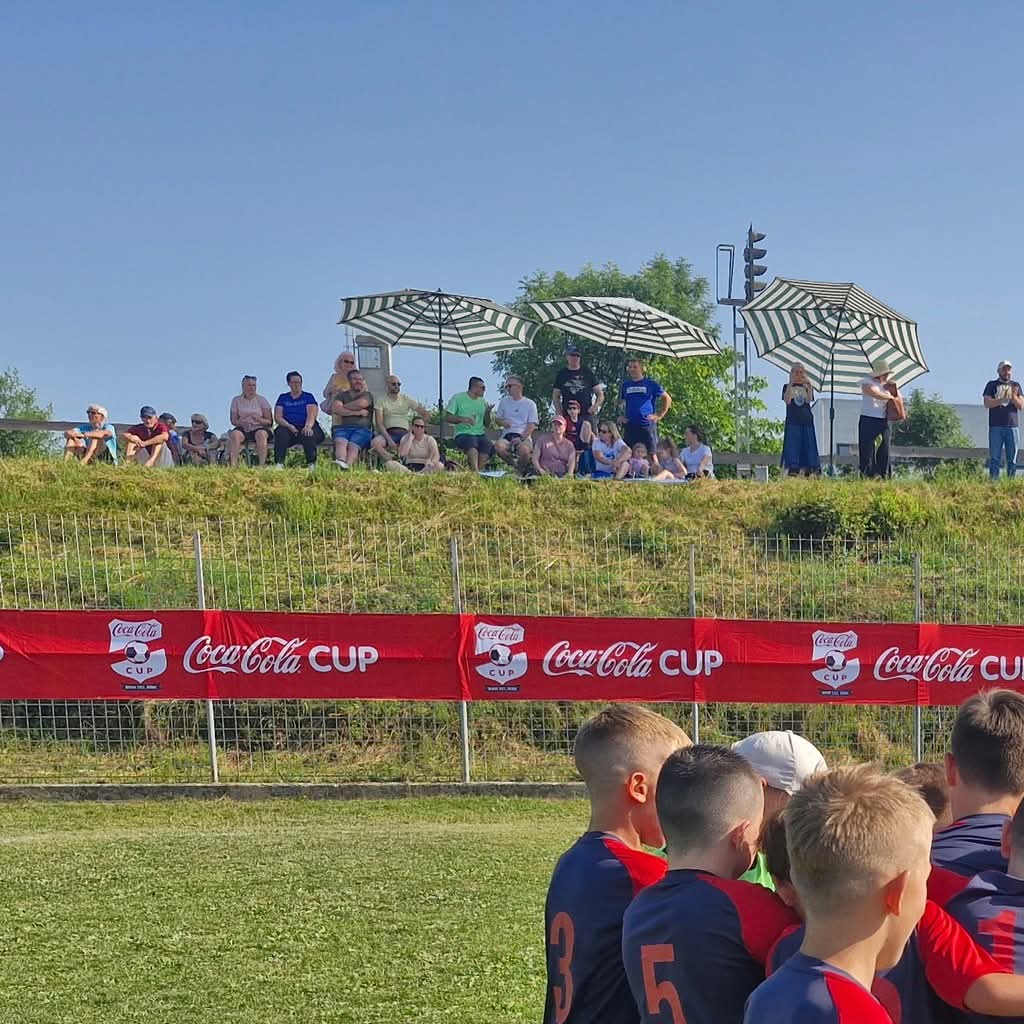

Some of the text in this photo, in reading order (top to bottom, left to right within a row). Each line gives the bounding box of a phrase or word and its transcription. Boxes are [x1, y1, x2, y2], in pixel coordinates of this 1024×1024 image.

[183, 635, 379, 674] Coca-Cola CUP
[543, 640, 723, 677] Coca-Cola CUP
[873, 647, 980, 682] Coca-Cola
[489, 669, 515, 677] CUP
[823, 674, 848, 682] CUP
[550, 912, 576, 1024] 3
